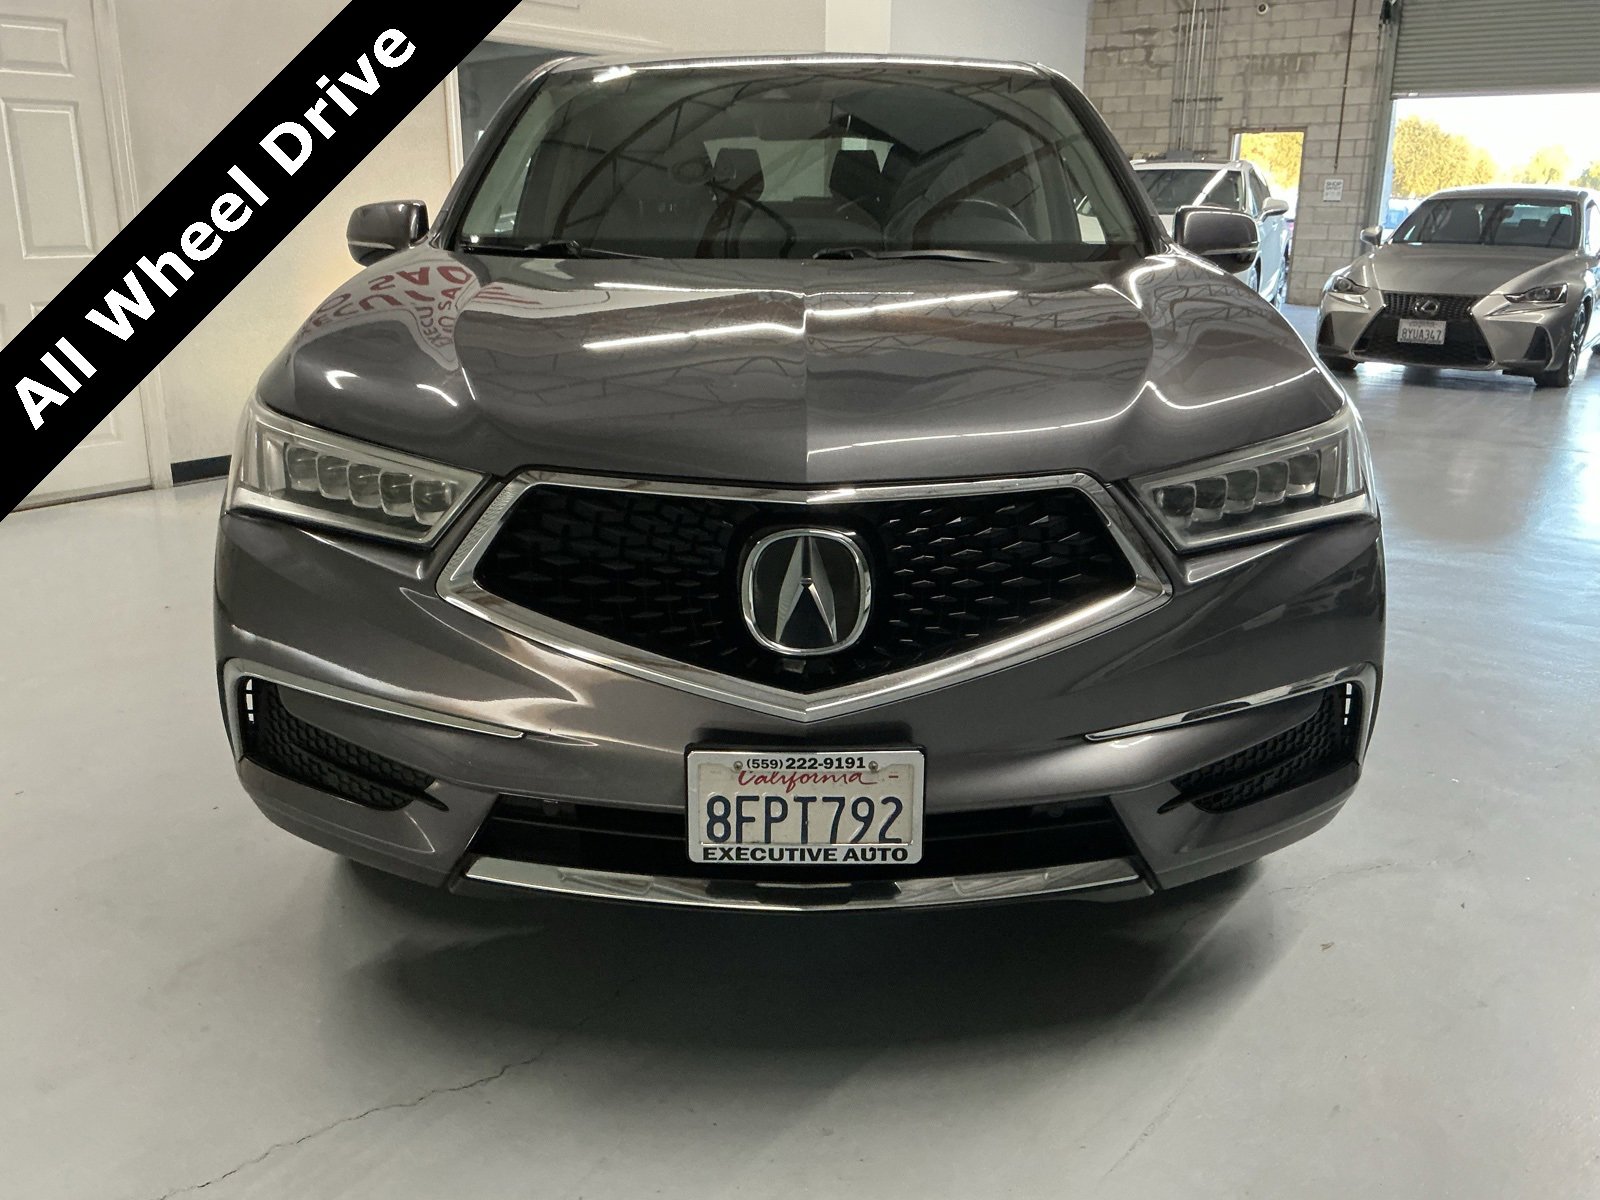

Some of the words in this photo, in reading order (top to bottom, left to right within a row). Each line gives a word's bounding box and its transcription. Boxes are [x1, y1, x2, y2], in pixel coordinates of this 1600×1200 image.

[1401, 327, 1442, 341] 8YUA347
[746, 758, 783, 769] (559)
[786, 757, 865, 769] 222-9191
[738, 771, 878, 793] California
[706, 795, 903, 844] 8FPT792
[703, 847, 837, 861] EXECUTIVE
[843, 847, 908, 861] AUTO
